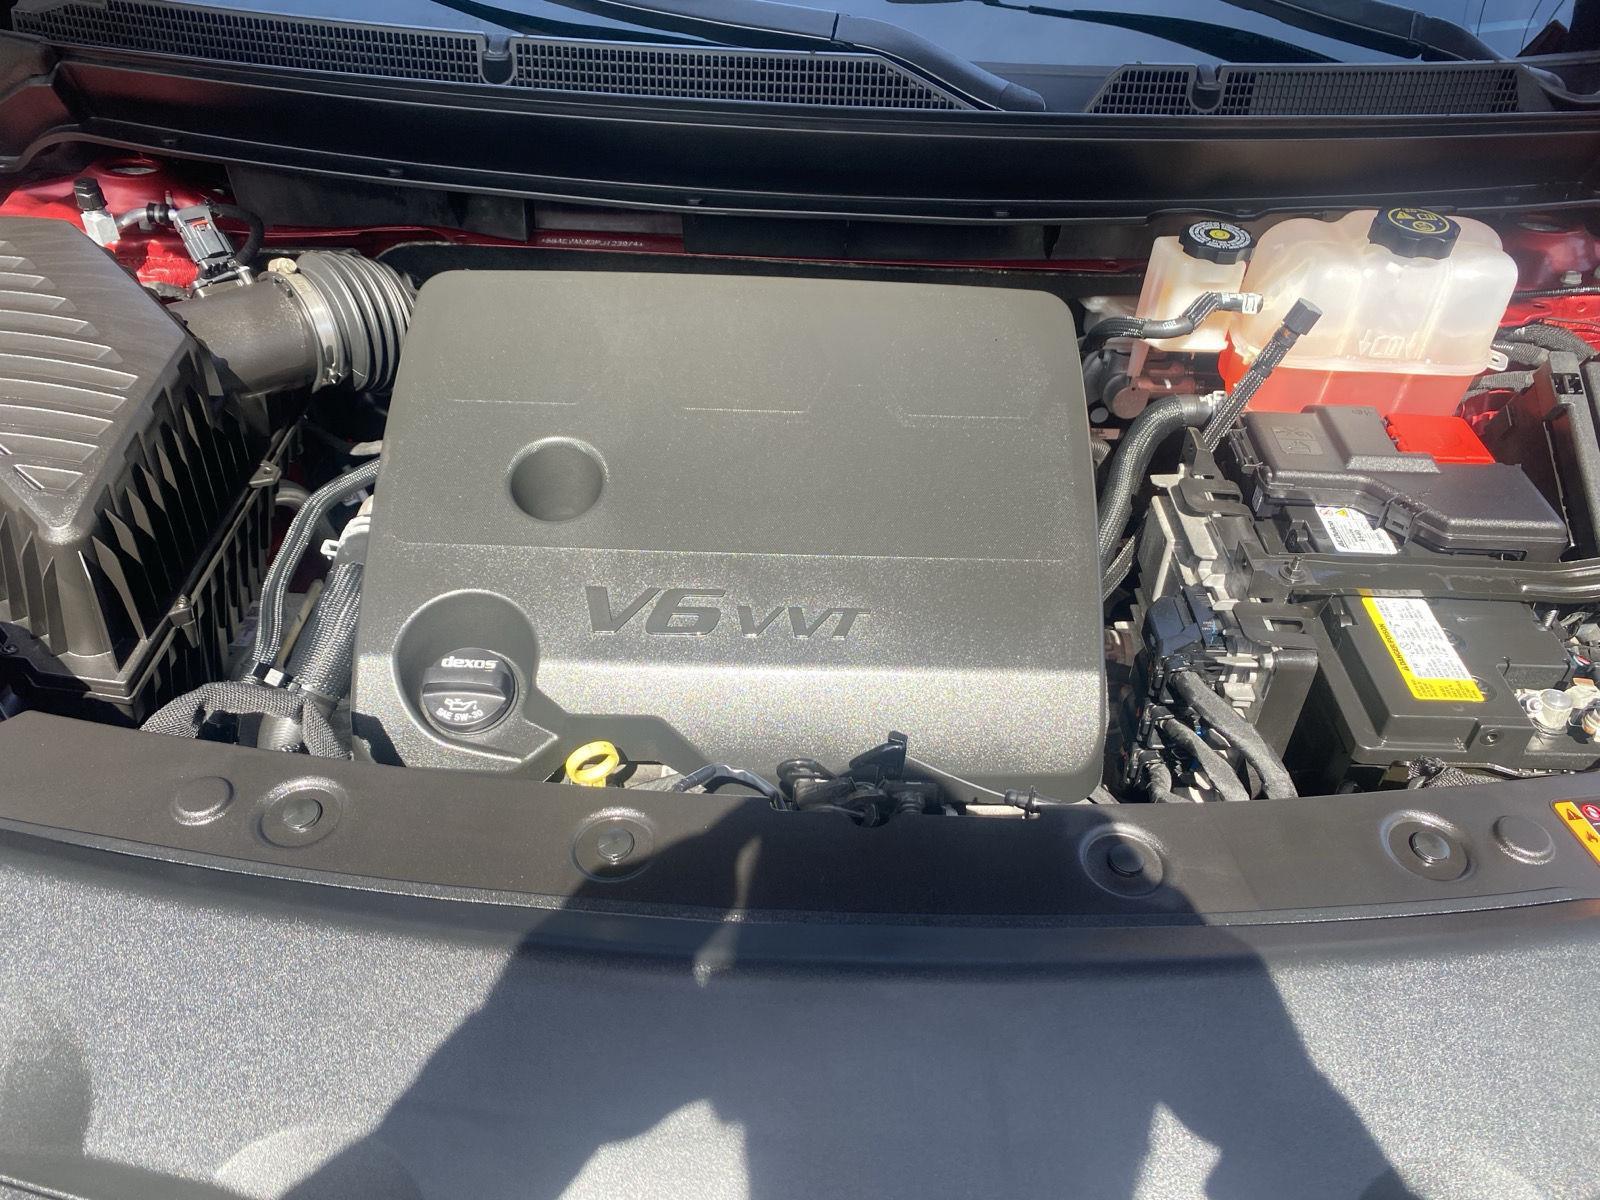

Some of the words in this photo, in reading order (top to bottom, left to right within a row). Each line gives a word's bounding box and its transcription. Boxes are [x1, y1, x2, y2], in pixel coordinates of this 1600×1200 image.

[585, 586, 726, 636] V6
[737, 606, 871, 640] VVT
[441, 656, 499, 669] dexos
[436, 707, 453, 721] SAE
[454, 709, 484, 721] 5W-30
